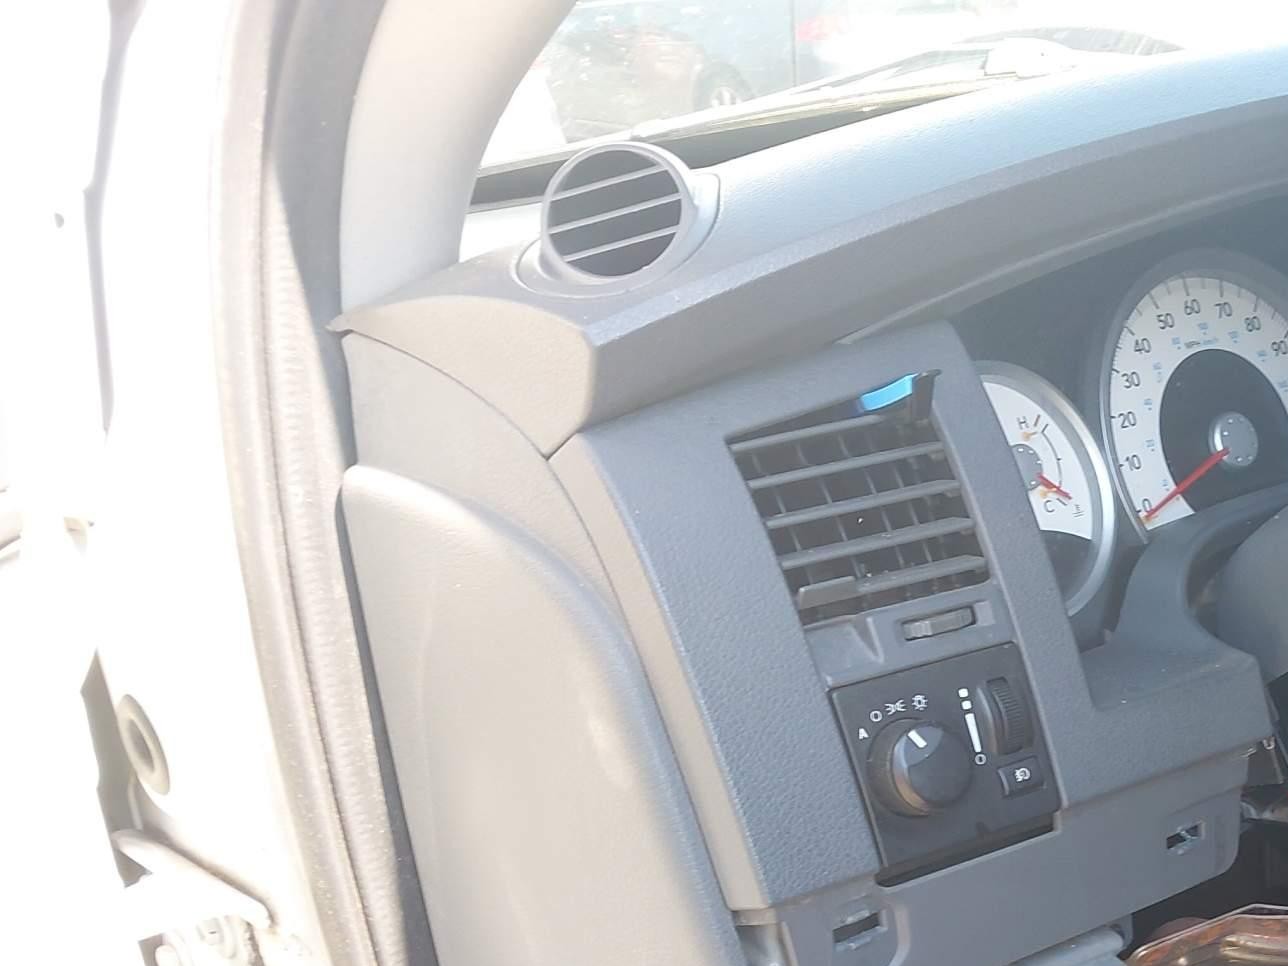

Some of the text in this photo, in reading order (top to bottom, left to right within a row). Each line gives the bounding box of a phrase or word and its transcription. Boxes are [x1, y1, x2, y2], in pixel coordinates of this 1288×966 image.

[1184, 299, 1201, 315] 60
[1214, 302, 1233, 319] 70
[1156, 313, 1175, 329] 50
[1244, 316, 1261, 332] 80
[1134, 338, 1151, 354] 40
[1271, 340, 1288, 357] 90
[1121, 371, 1140, 389] 30
[1016, 415, 1030, 430] H
[1118, 411, 1137, 428] 20
[1125, 454, 1142, 471] 10
[1044, 499, 1056, 513] C
